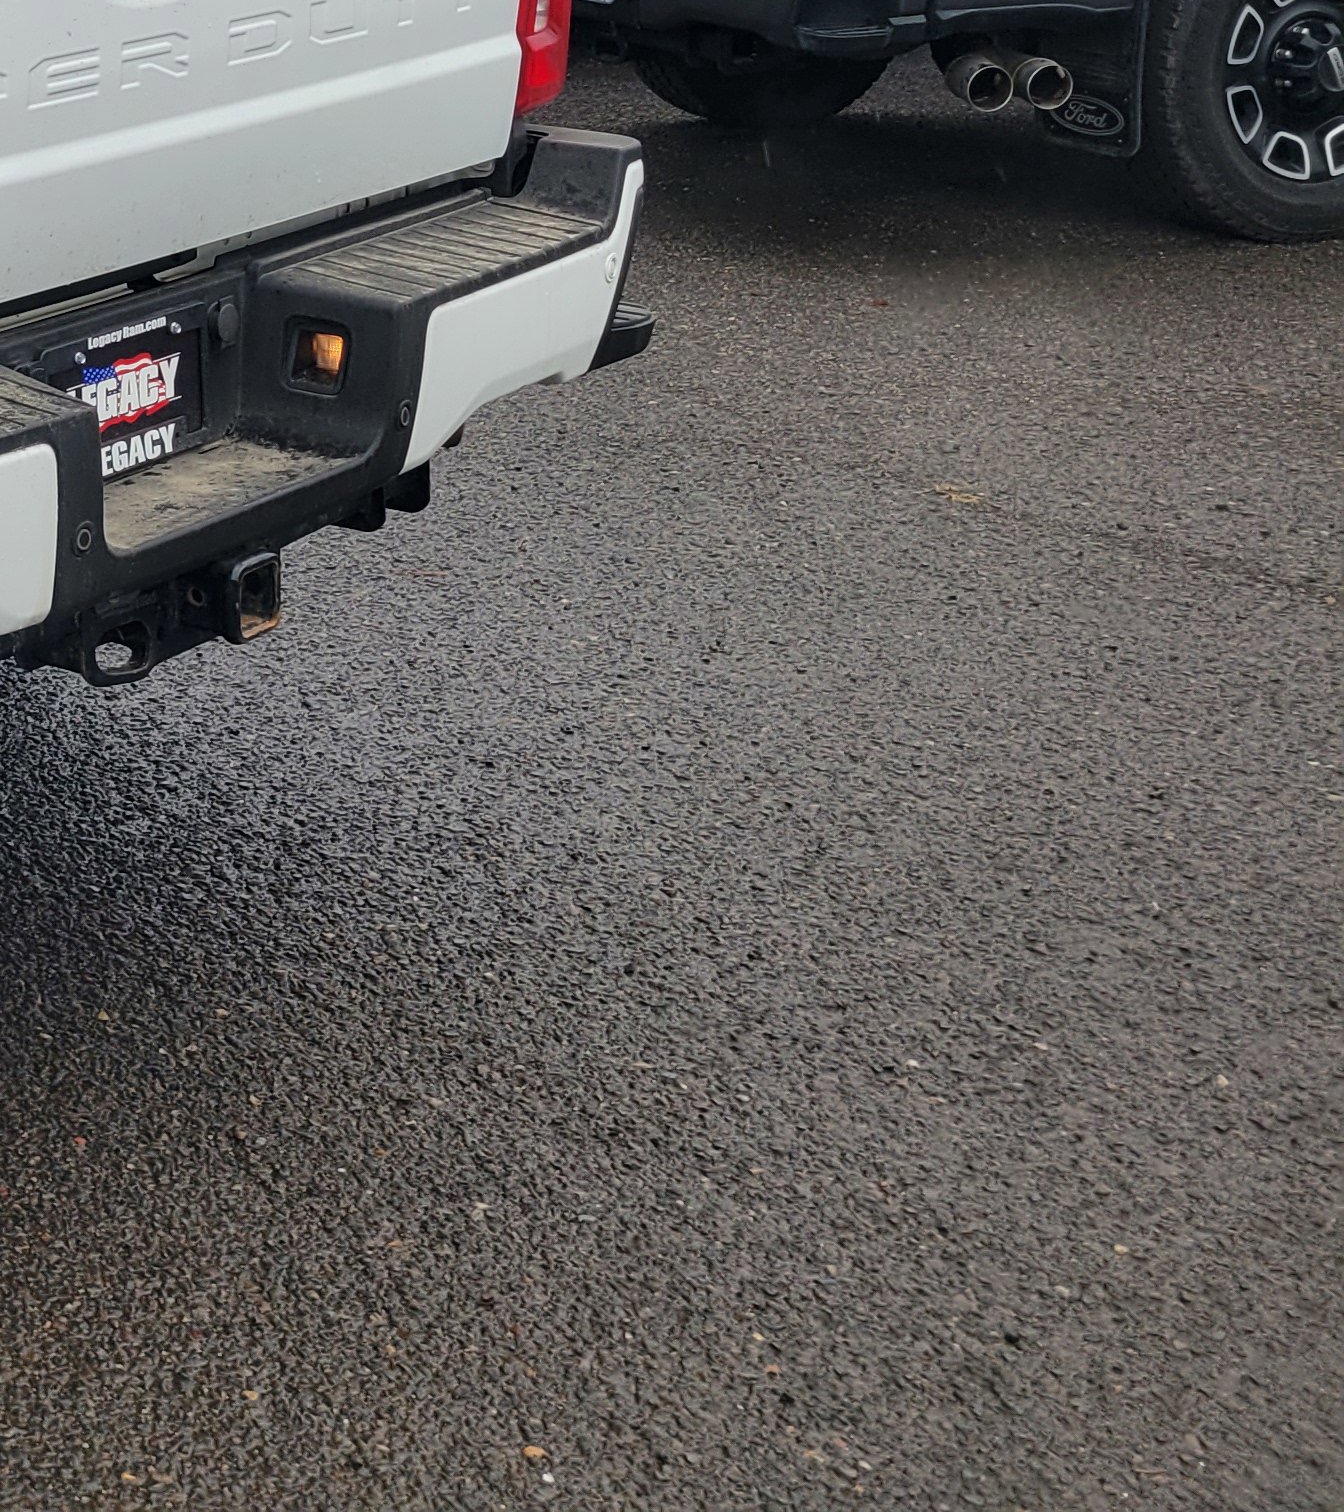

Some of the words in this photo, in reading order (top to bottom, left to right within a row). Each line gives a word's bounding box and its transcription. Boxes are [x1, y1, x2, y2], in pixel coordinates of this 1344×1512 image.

[1064, 100, 1108, 129] Ford
[66, 356, 180, 422] EGACY
[101, 423, 176, 477] EGACY
